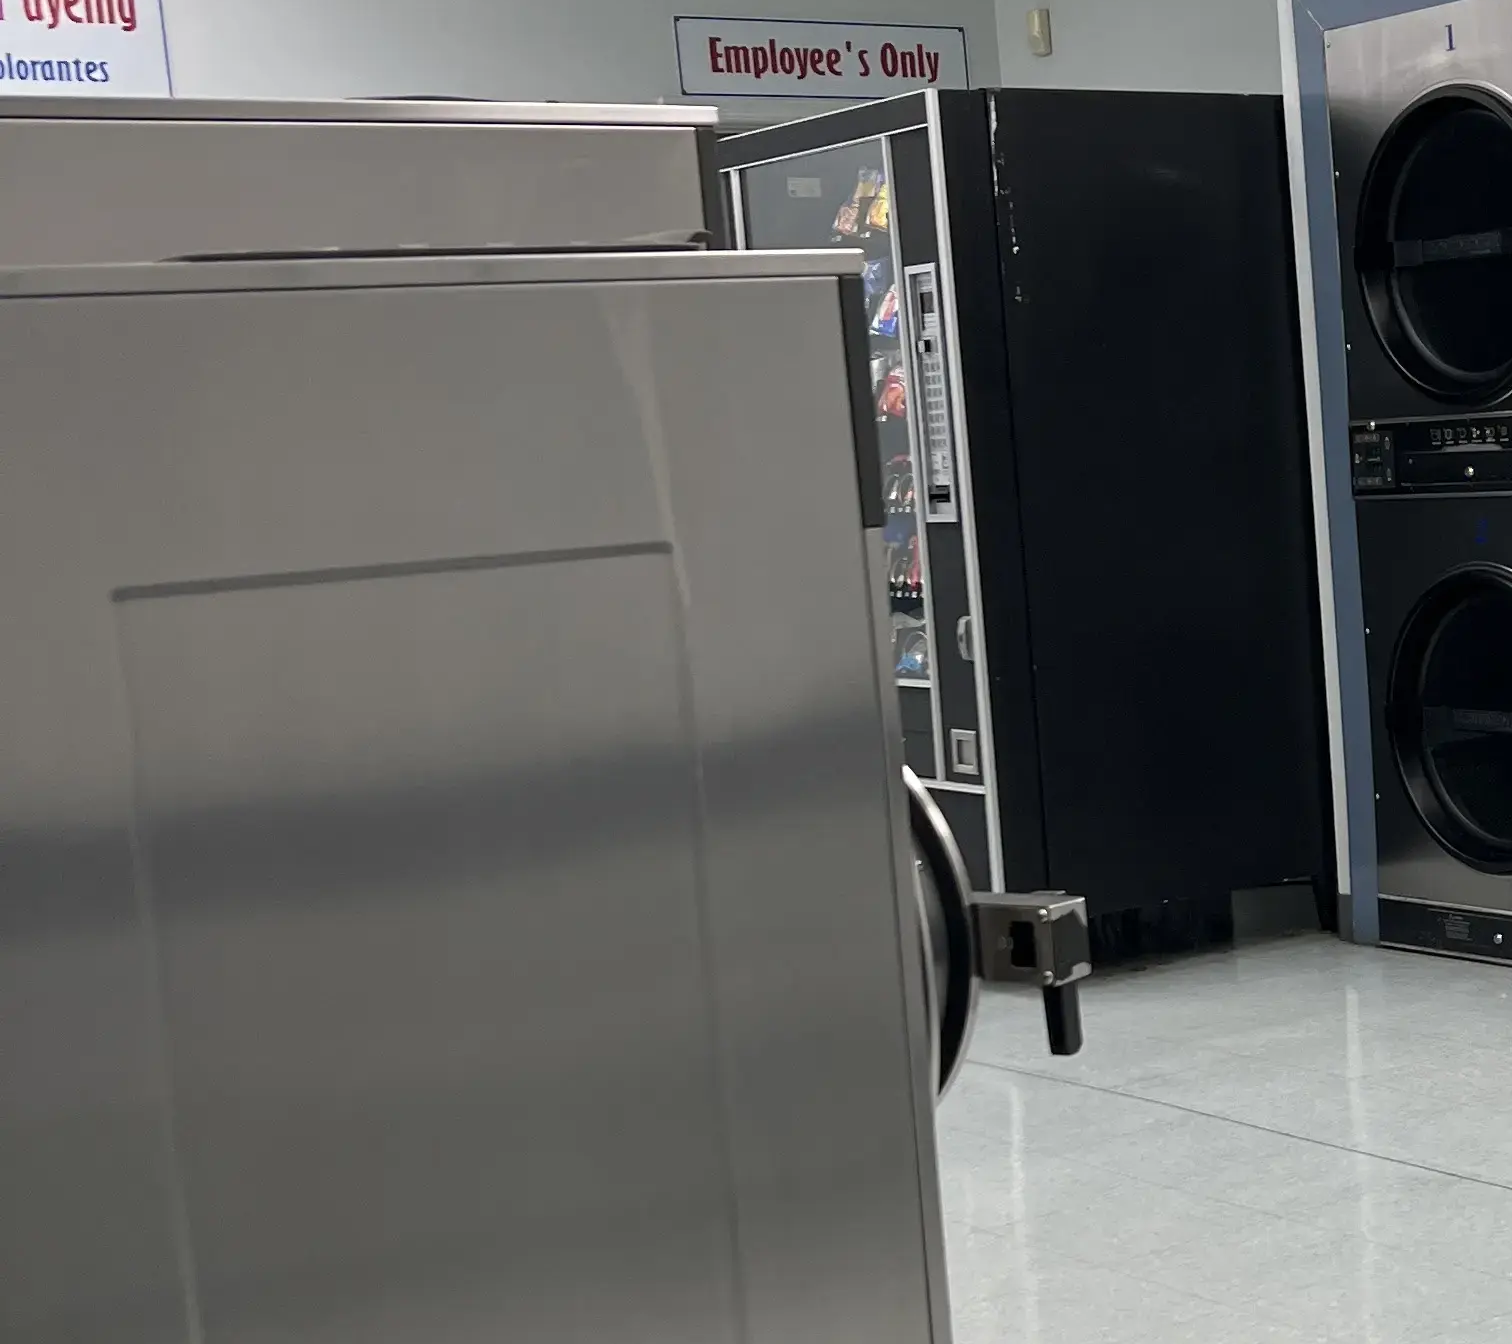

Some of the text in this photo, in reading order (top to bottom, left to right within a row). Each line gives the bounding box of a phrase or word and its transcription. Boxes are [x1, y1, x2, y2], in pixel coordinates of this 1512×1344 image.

[1444, 24, 1456, 52] 1
[708, 36, 939, 83] Employee's Only
